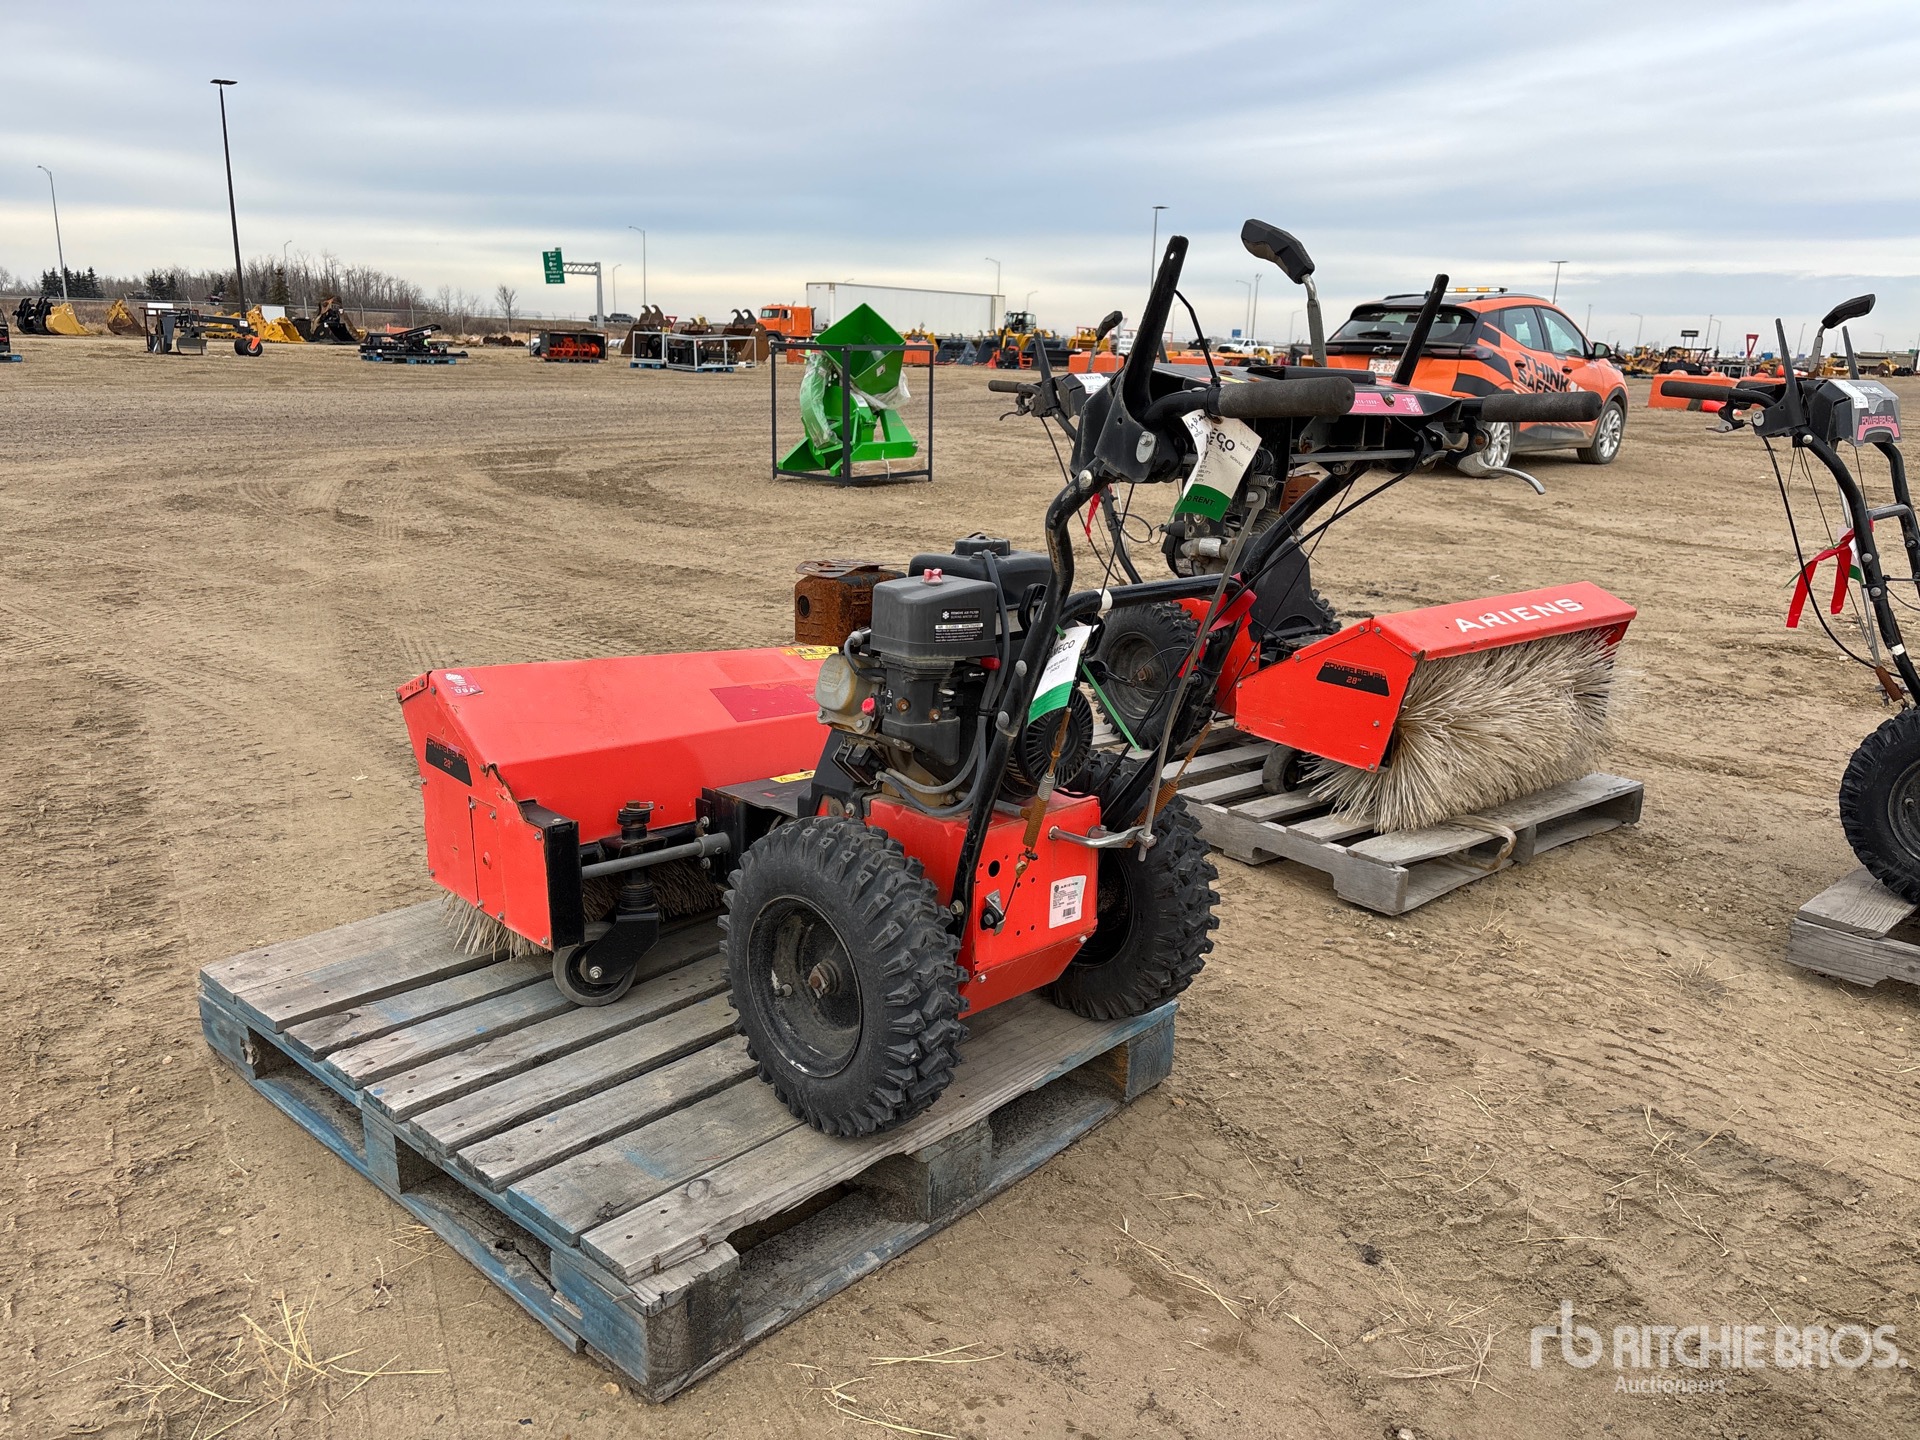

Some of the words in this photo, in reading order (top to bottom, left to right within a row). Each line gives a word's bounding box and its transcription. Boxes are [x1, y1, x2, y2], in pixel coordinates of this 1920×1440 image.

[1518, 368, 1557, 393] SAFE
[1519, 351, 1571, 392] THINK
[1193, 496, 1216, 506] RENT
[1455, 598, 1584, 633] ARIENS
[1324, 661, 1356, 675] POWER
[1356, 668, 1387, 681] BRUSH
